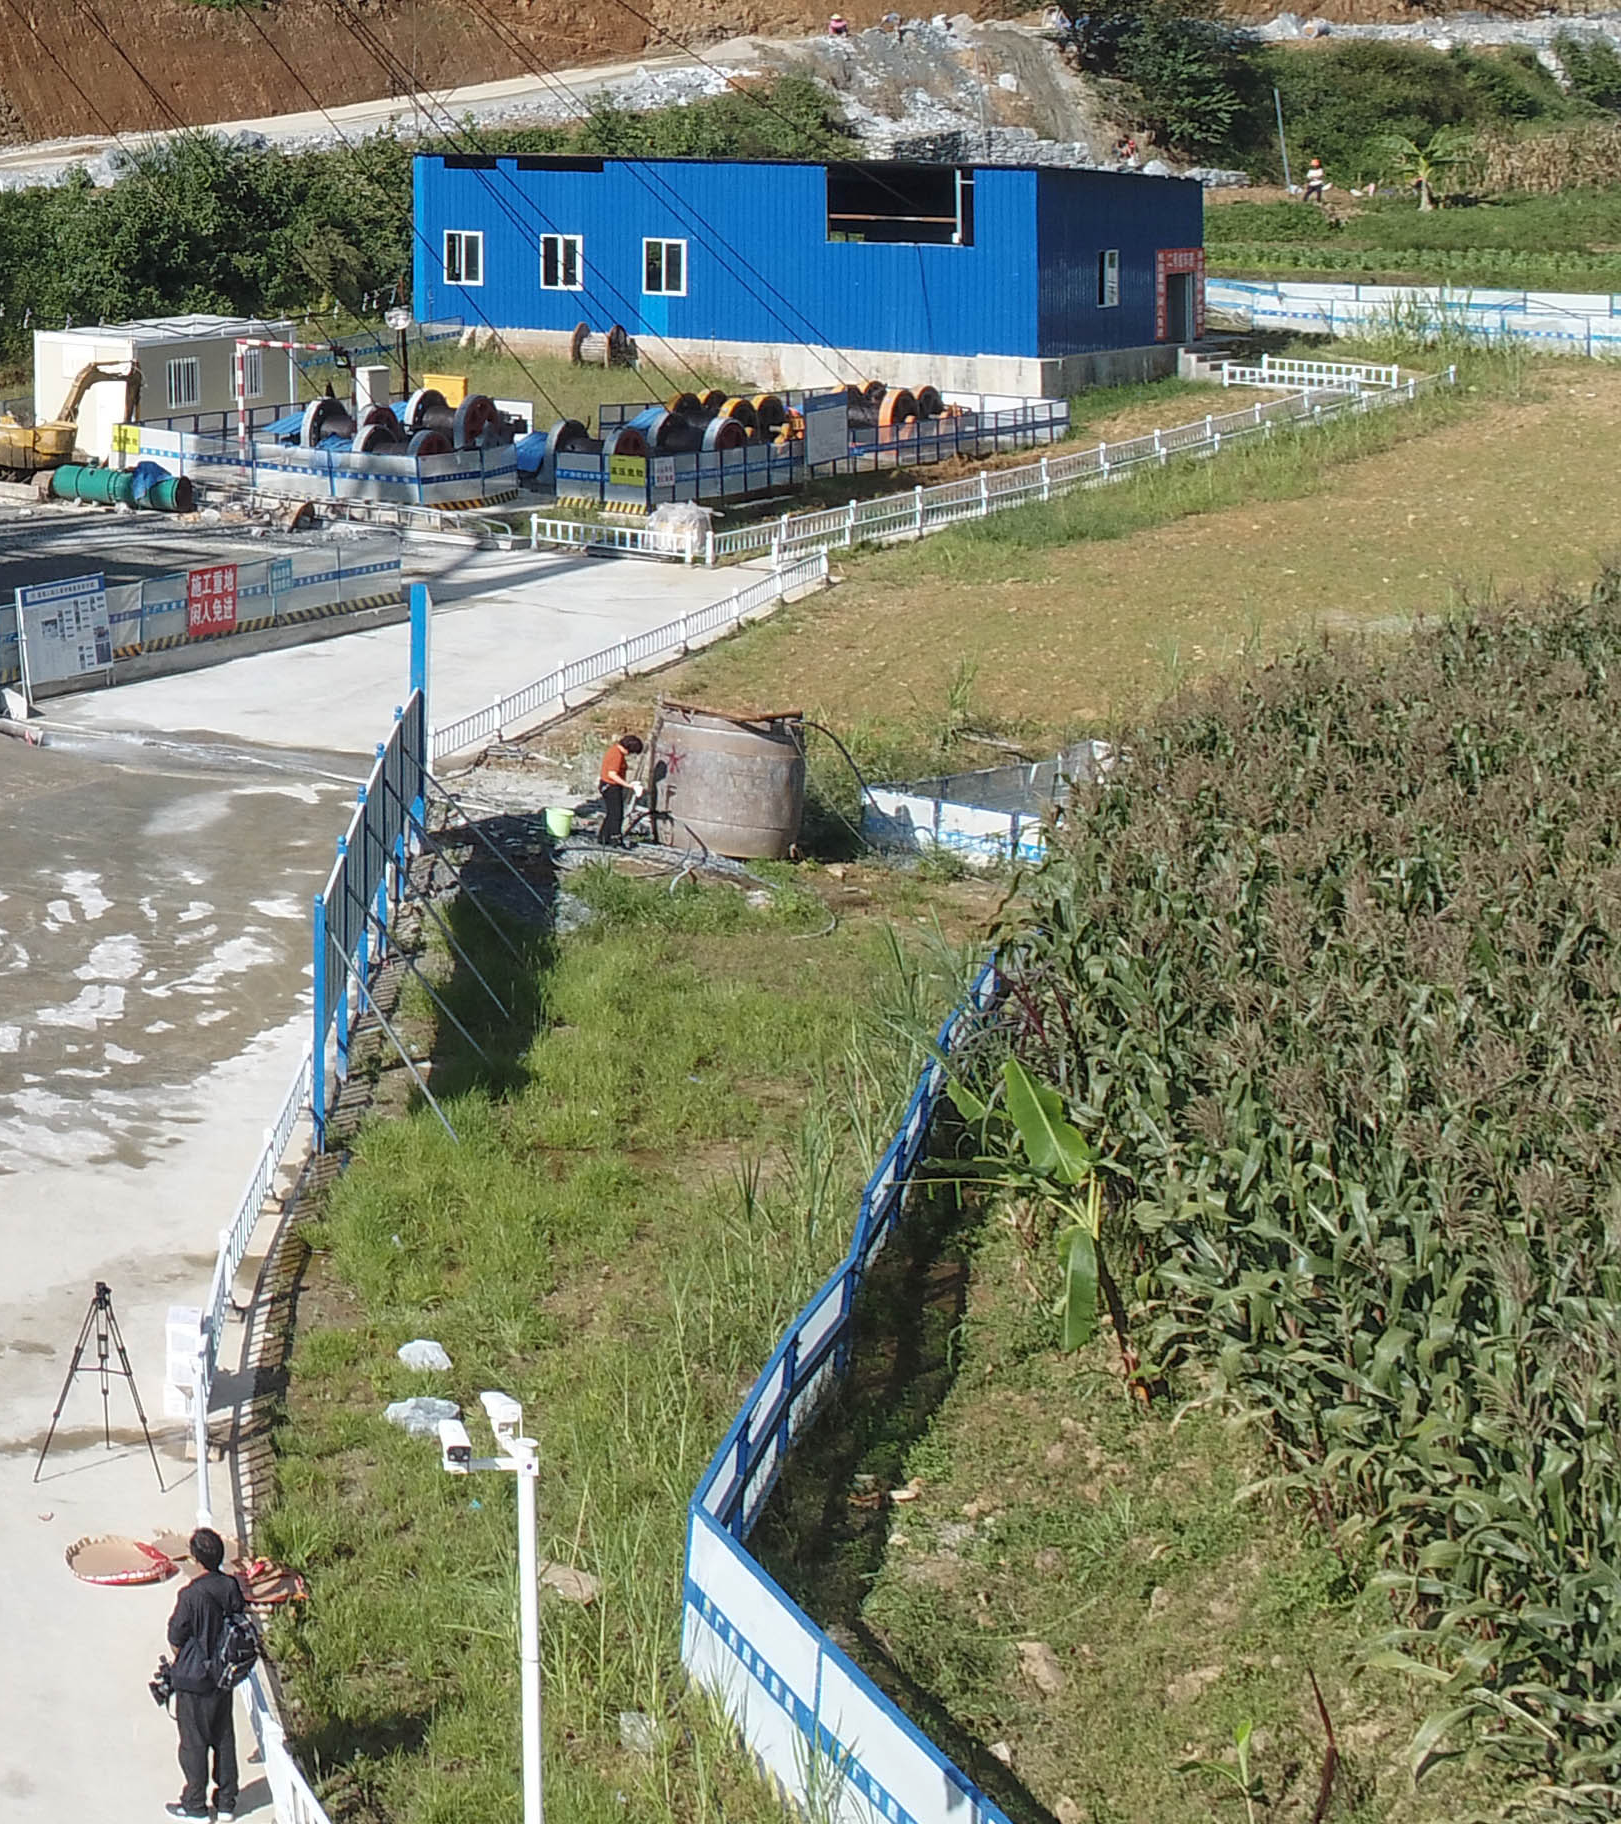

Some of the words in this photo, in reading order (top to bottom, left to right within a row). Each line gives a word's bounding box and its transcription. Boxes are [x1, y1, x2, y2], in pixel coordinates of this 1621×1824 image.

[191, 568, 234, 598] 施工重地
[190, 596, 233, 626] 闲人免进
